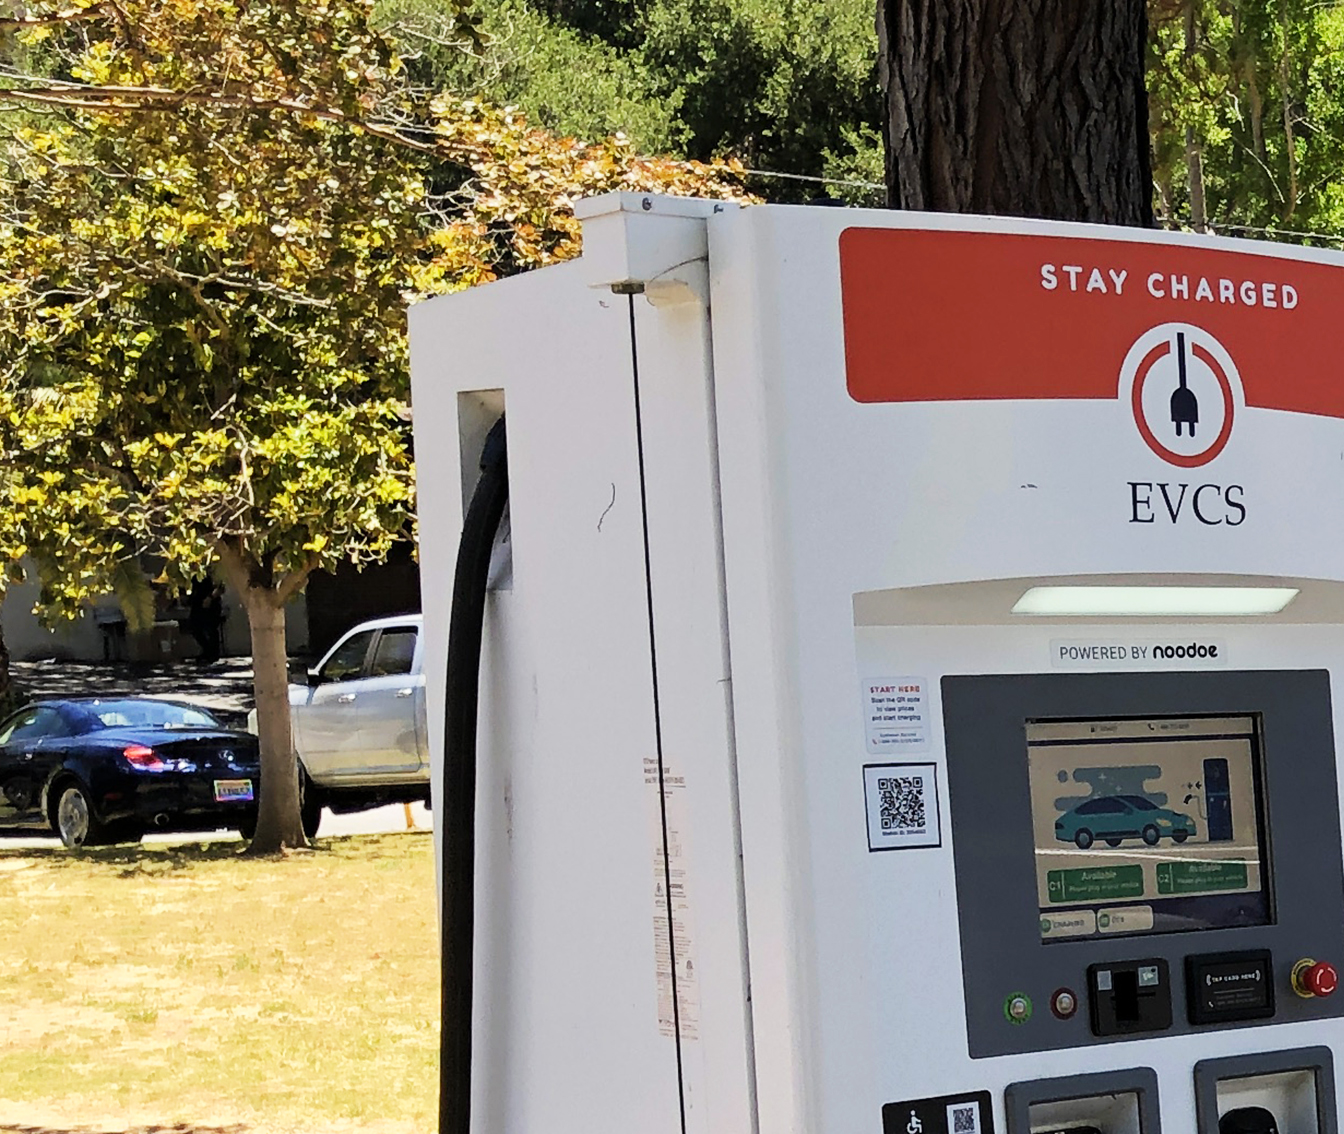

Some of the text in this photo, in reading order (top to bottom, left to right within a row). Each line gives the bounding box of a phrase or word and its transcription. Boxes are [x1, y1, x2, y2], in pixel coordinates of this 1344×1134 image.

[1040, 263, 1298, 310] STAY CHARGED
[1127, 481, 1247, 526] EVCS
[1059, 642, 1219, 660] POWERED BY noodoe
[870, 685, 896, 694] START
